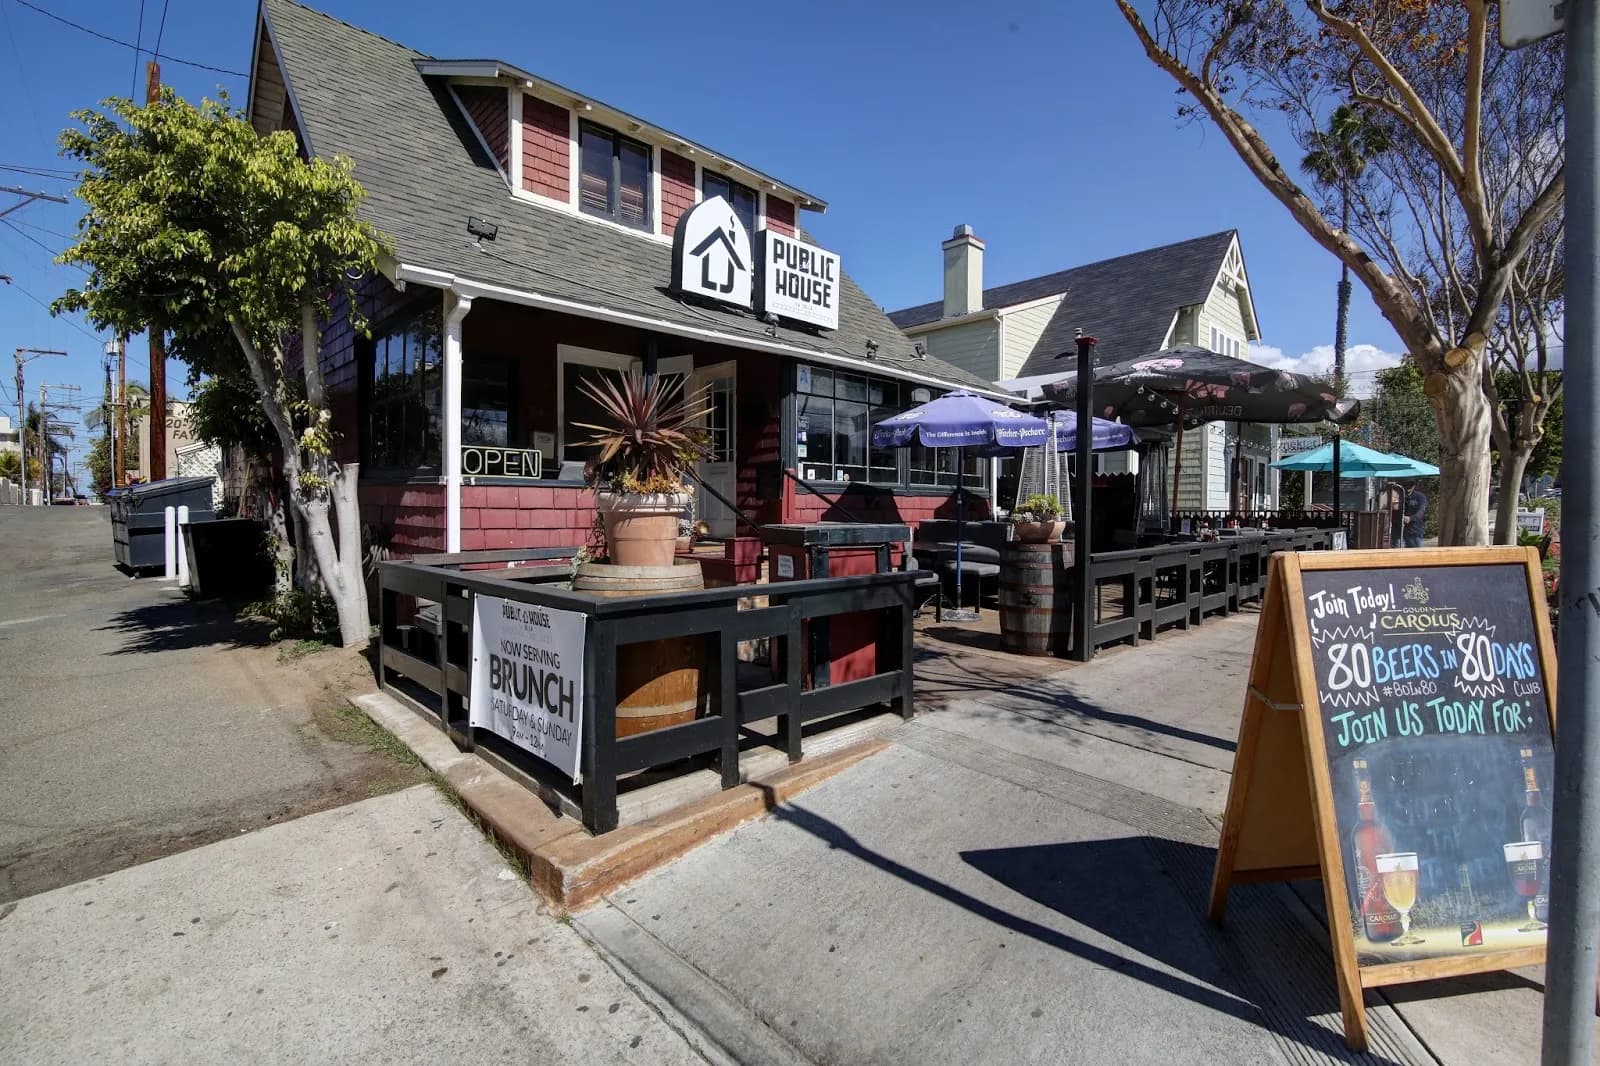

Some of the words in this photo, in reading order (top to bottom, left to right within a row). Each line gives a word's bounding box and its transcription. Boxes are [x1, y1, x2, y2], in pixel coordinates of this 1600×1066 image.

[773, 238, 834, 283] PUBLIC
[775, 268, 831, 309] HOUSE
[463, 449, 538, 477] OPEN
[1309, 590, 1350, 619] Join
[1347, 583, 1396, 614] Today!
[1403, 606, 1435, 614] GOUDEN
[528, 610, 551, 629] HOUSE
[1381, 613, 1460, 631] CAROLUS
[501, 640, 522, 657] NOW
[523, 645, 560, 669] SERVING
[1328, 643, 1371, 690] 80
[1372, 643, 1440, 683] BEERS
[1440, 649, 1458, 669] IN
[1457, 632, 1495, 681] 80
[1491, 642, 1535, 679] DAYS
[490, 654, 574, 723] BRUNCH
[530, 713, 537, 730] &
[537, 717, 573, 748] SUNDAY
[1331, 707, 1388, 747] JOIN
[1395, 700, 1424, 736] US
[1426, 696, 1485, 734] TODAY
[1492, 699, 1533, 733] FOR:
